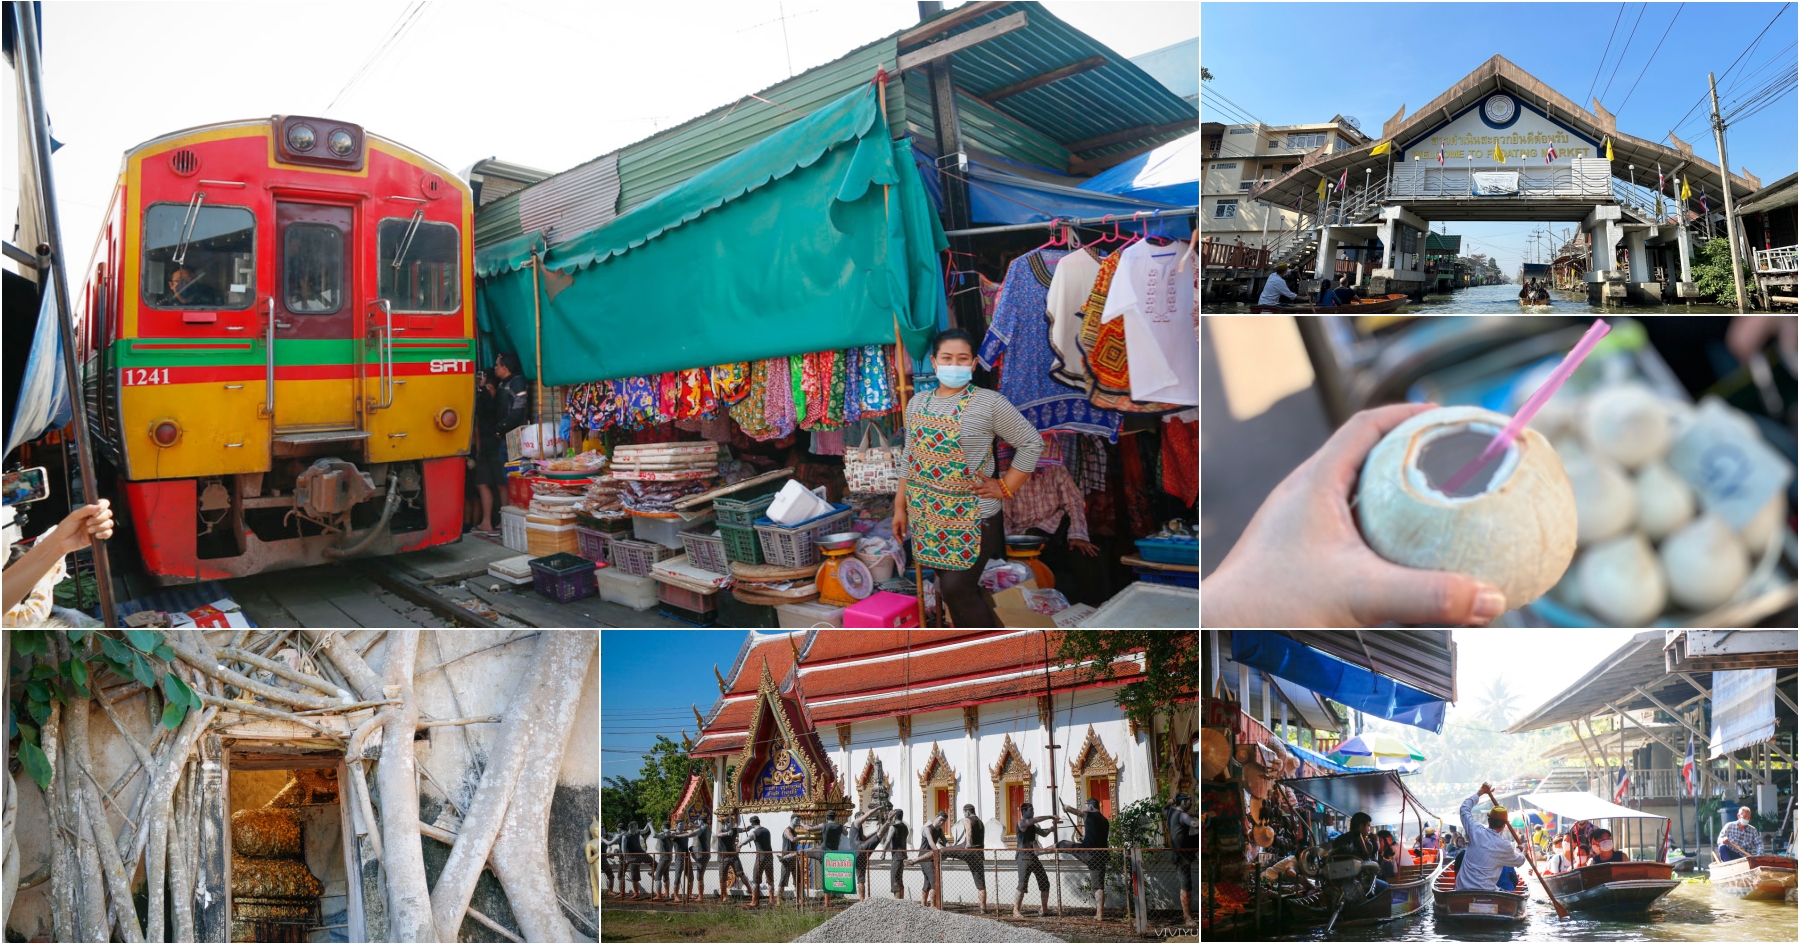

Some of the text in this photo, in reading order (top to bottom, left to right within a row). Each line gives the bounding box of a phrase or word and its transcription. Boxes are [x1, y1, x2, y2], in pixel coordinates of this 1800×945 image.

[1411, 149, 1465, 159] WELCOME
[1468, 149, 1483, 158] TO
[1541, 147, 1590, 157] MRKET
[430, 358, 471, 373] SRT
[125, 367, 171, 386] 1241
